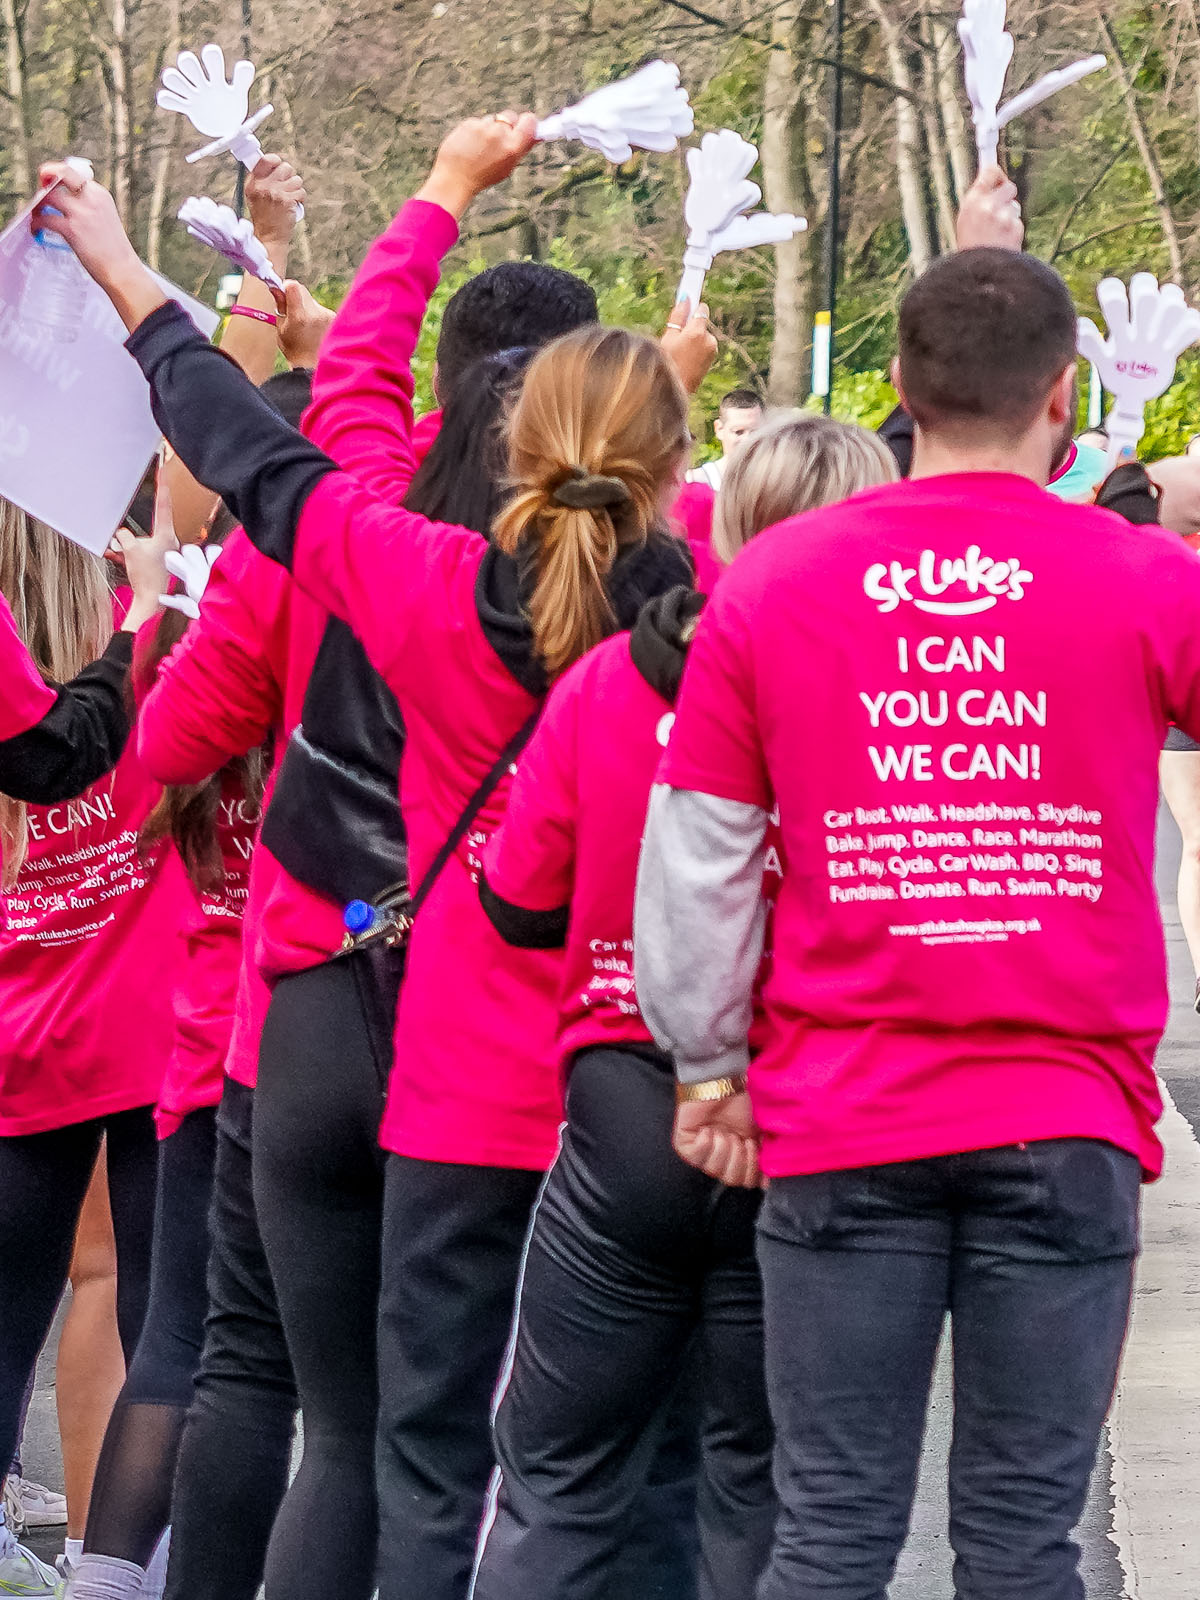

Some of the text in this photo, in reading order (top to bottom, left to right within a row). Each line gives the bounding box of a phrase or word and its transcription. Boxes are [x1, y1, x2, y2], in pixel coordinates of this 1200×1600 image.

[864, 545, 1034, 613] St Luke's
[898, 636, 1005, 672] I CAN
[860, 690, 1046, 727] YOU CAN
[868, 744, 1040, 781] WE CAN!
[47, 792, 117, 835] CAN!
[823, 810, 854, 828] Car
[892, 804, 939, 823] Walk.
[940, 802, 1035, 821] Headshave.
[1037, 802, 1102, 826] Skydive
[866, 832, 911, 853] Jump.
[912, 829, 971, 848] Dance.
[972, 828, 1018, 847] Race.
[1019, 828, 1102, 849] Marathon
[888, 854, 938, 879] Cycle.
[939, 853, 969, 872] Car
[969, 851, 1020, 871] Wash.
[1064, 854, 1103, 878] Sing
[899, 880, 966, 900] Donate.
[967, 878, 1006, 896] Run.
[1006, 877, 1056, 896] Swim.
[1056, 878, 1103, 903] Party
